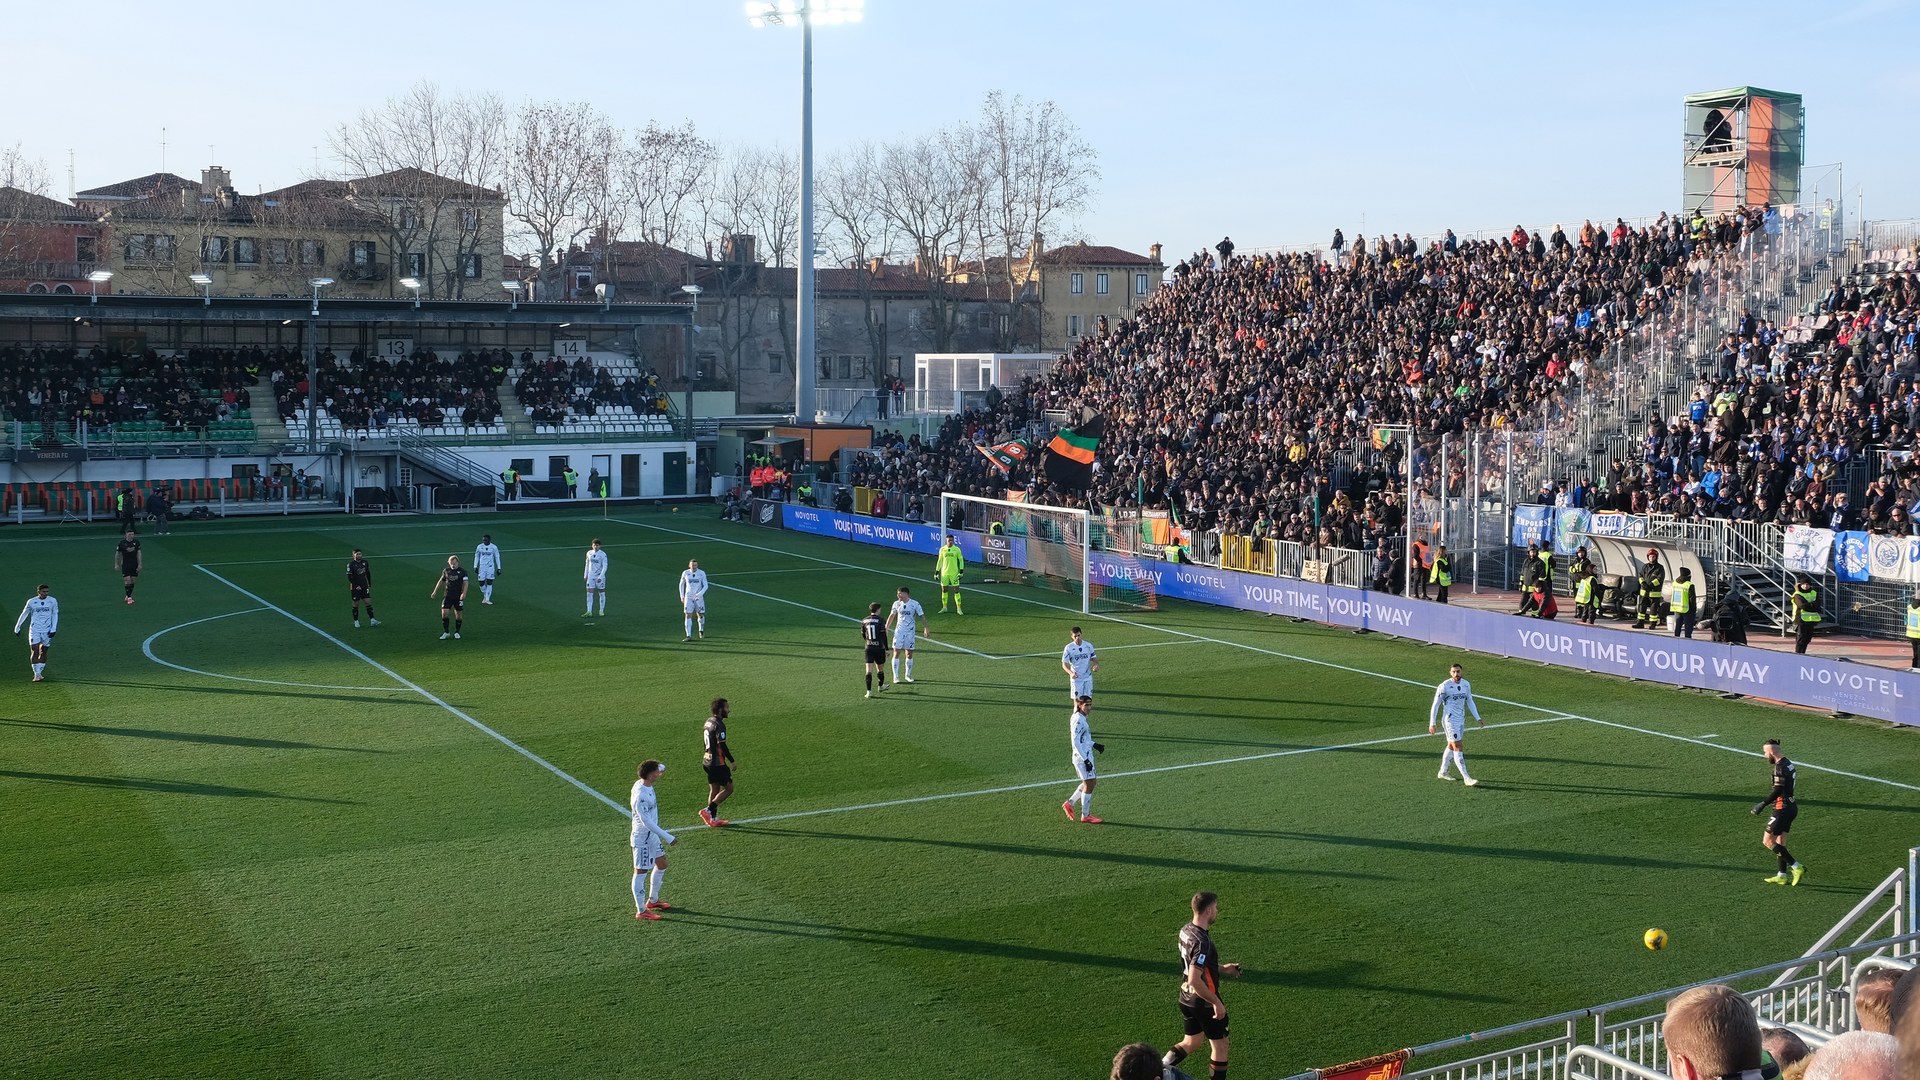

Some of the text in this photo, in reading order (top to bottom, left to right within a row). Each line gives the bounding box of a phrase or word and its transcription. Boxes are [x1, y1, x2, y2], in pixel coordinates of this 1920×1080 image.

[387, 341, 405, 355] 13
[561, 342, 579, 355] 14
[795, 511, 820, 522] NOVOTEL
[1516, 515, 1551, 527] EMPOLESI
[833, 518, 914, 543] YOUR TIME, YOUR WAY
[1521, 532, 1542, 541] TOUR
[987, 551, 1005, 565] 09:51
[1100, 563, 1132, 580] YOUR
[1135, 568, 1163, 586] WAY
[1176, 571, 1226, 589] NOVOTEL
[1243, 584, 1413, 627] YOUR TIME, YOUR WAY
[866, 624, 876, 640] 11
[1518, 629, 1770, 684] YOUR TIME, YOUR WAY
[1800, 666, 1904, 698] NOVOTEL
[1833, 691, 1867, 701] VENEZIA
[1843, 699, 1890, 713] CASTELLANA
[1767, 816, 1776, 825] 7
